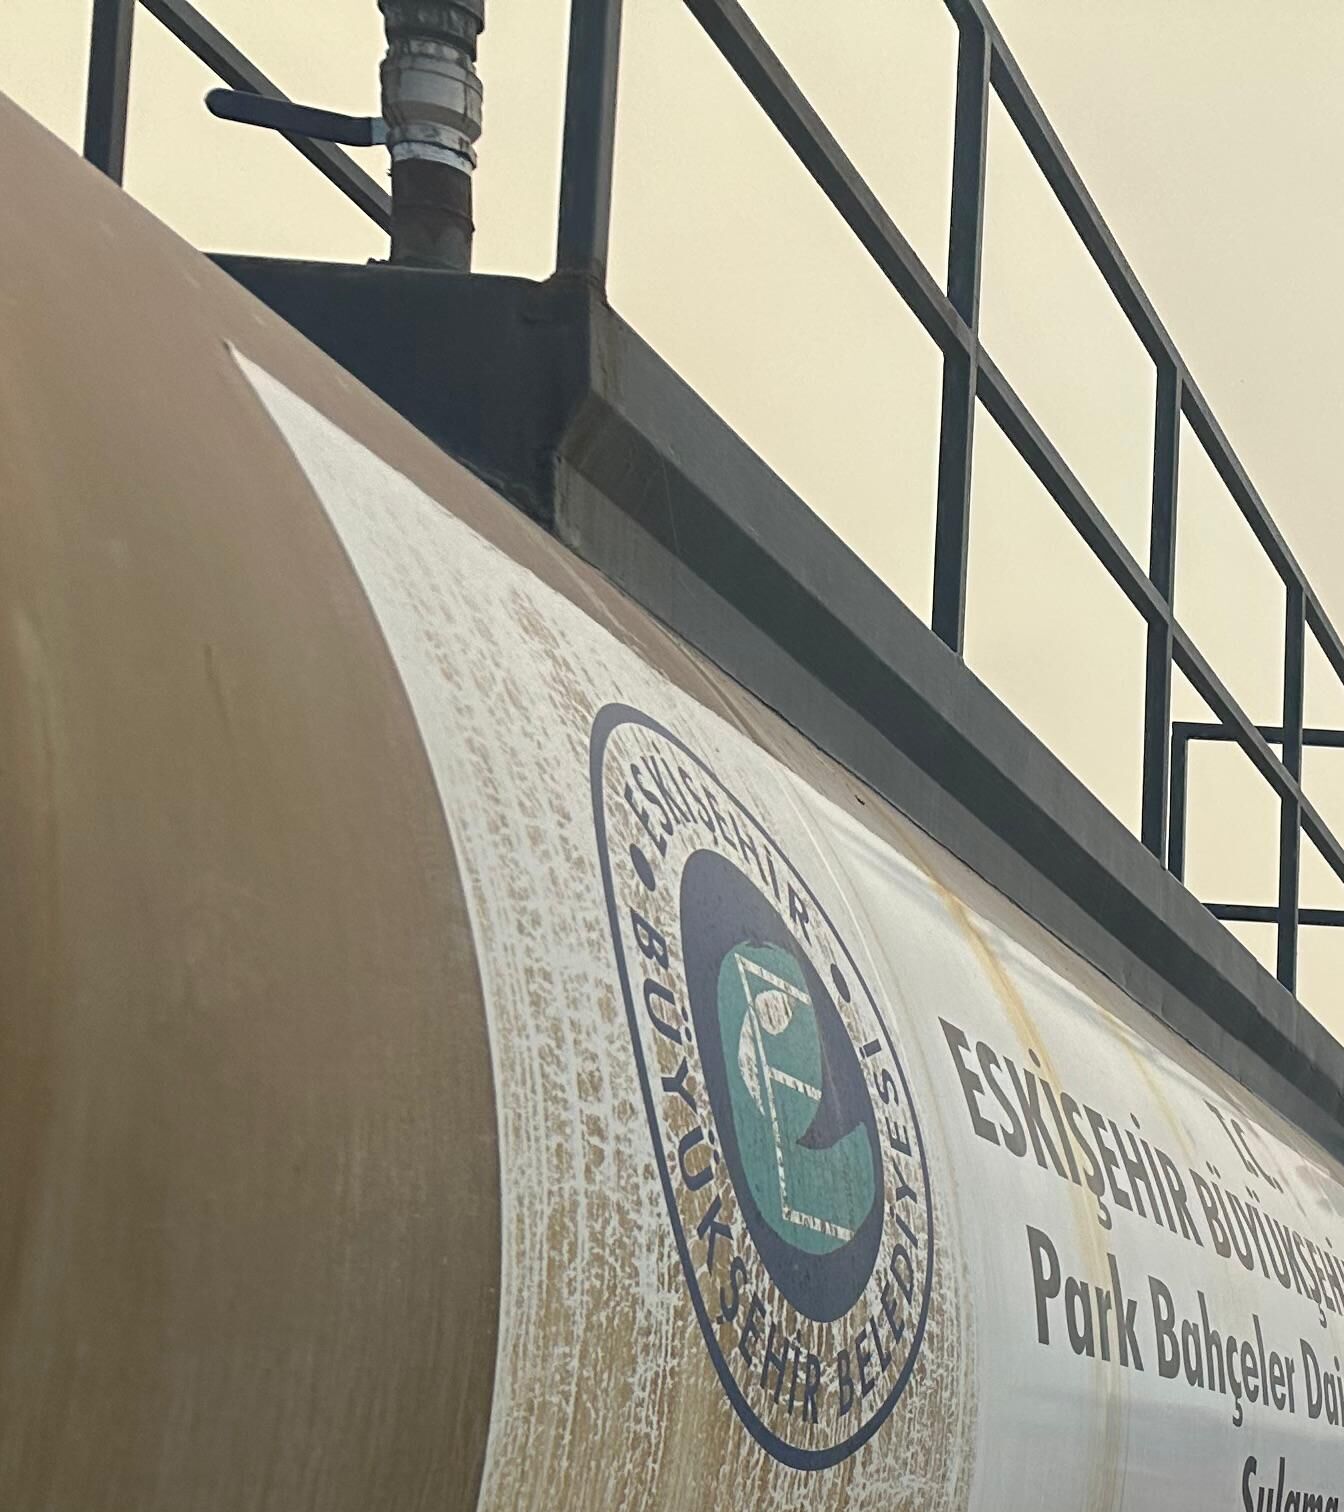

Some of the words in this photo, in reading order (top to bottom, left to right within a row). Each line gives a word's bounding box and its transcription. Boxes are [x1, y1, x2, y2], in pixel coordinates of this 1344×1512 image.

[837, 1039, 920, 1416] BELEDİYESİ
[938, 1016, 1204, 1247] ESKİŞEHİR
[1203, 1099, 1284, 1194] T.C.
[1026, 1224, 1144, 1372] Park
[1148, 1274, 1295, 1427] Bahçeler
